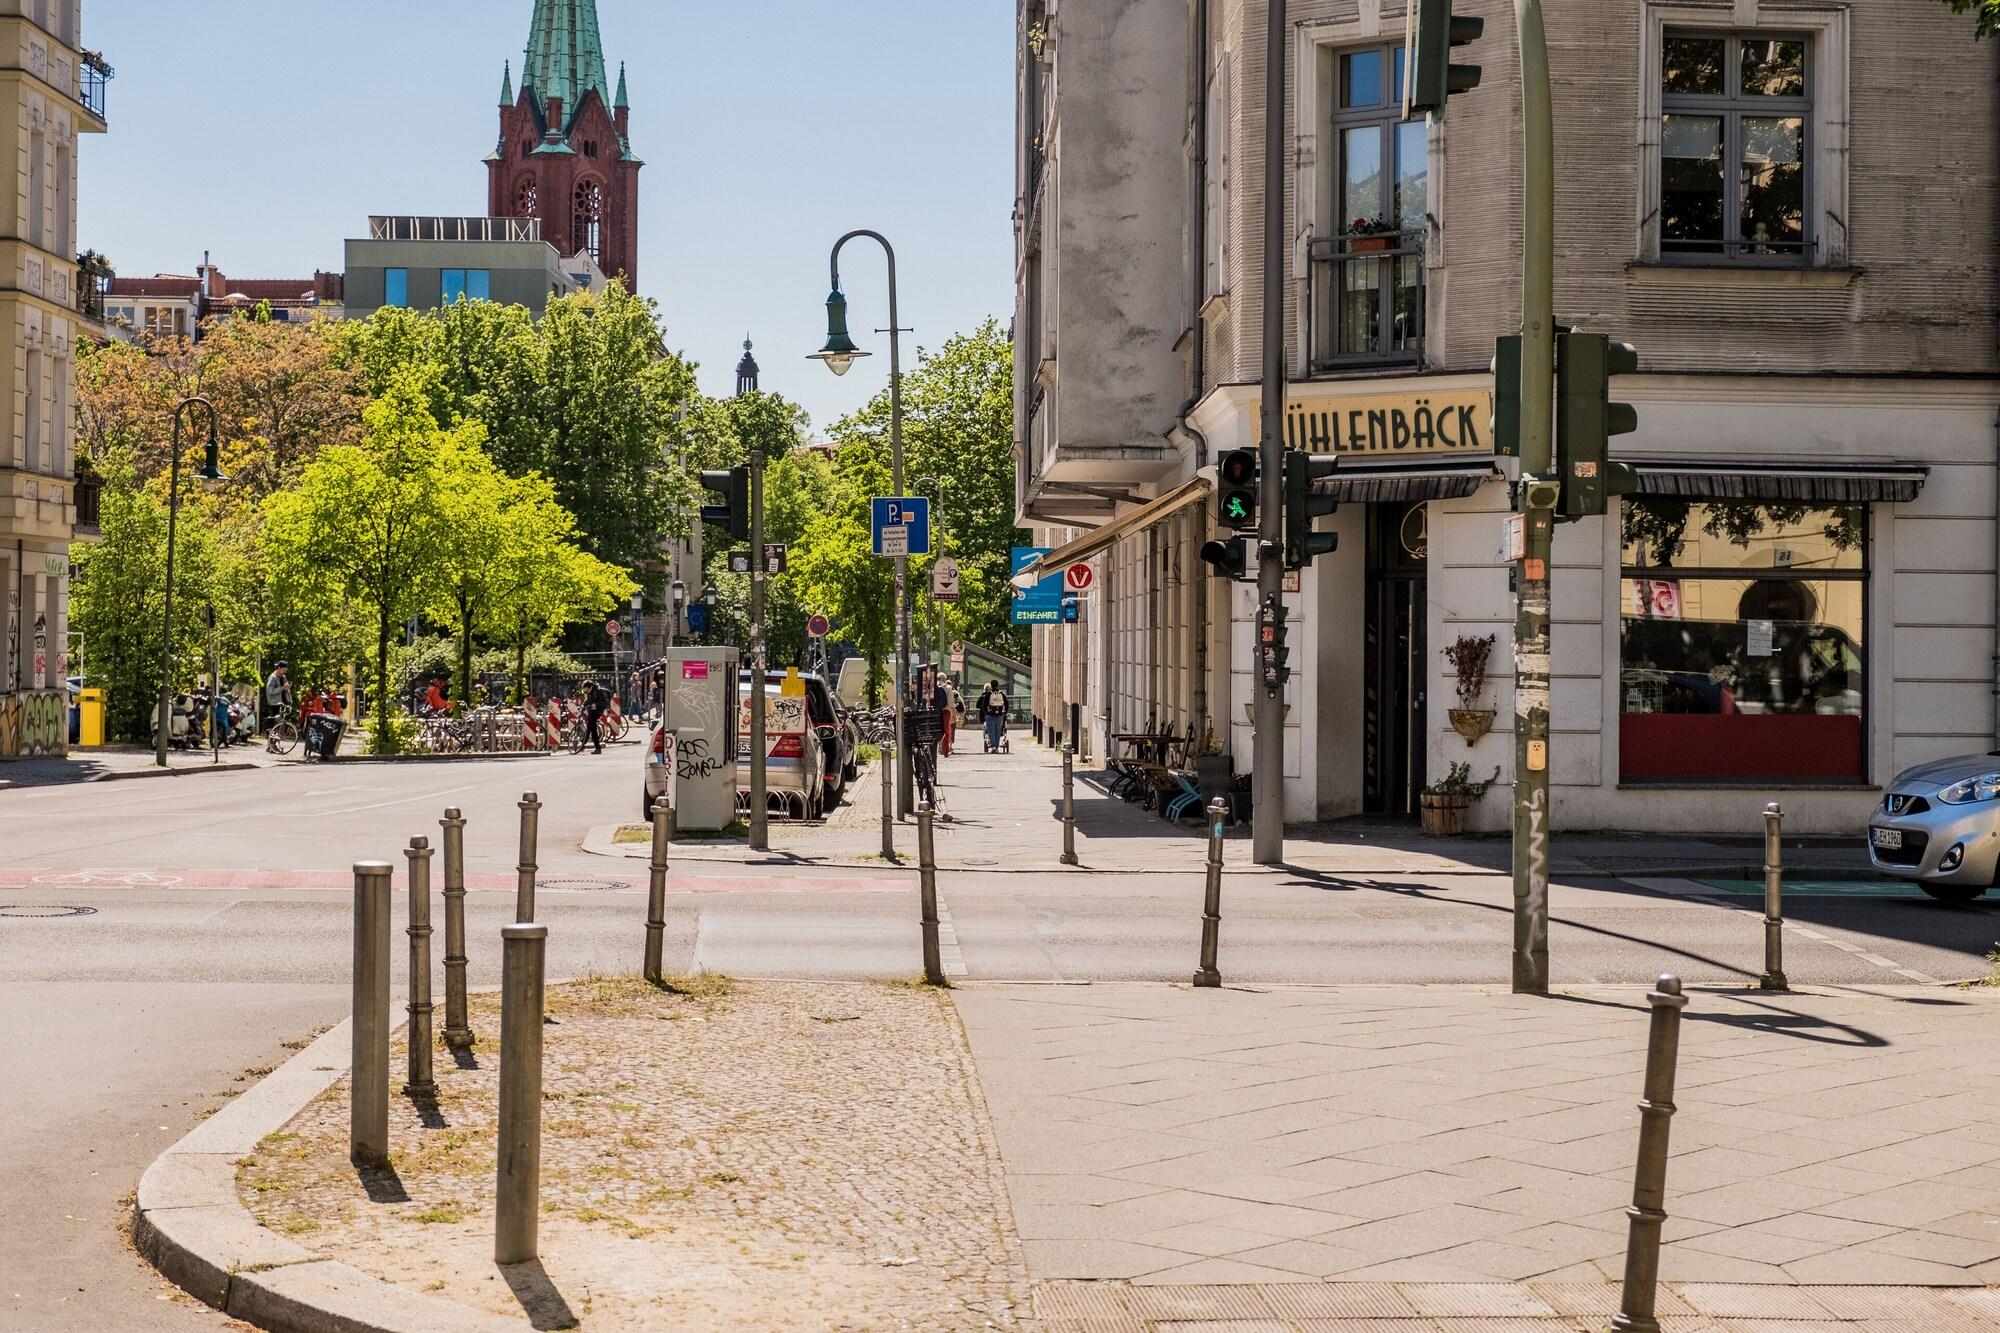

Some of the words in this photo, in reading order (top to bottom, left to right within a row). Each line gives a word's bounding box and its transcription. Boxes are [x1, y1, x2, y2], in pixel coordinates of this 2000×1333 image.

[1285, 399, 1480, 453] ÜHLENBÄCK
[888, 503, 898, 523] P
[1016, 611, 1059, 620] EINFAHRT
